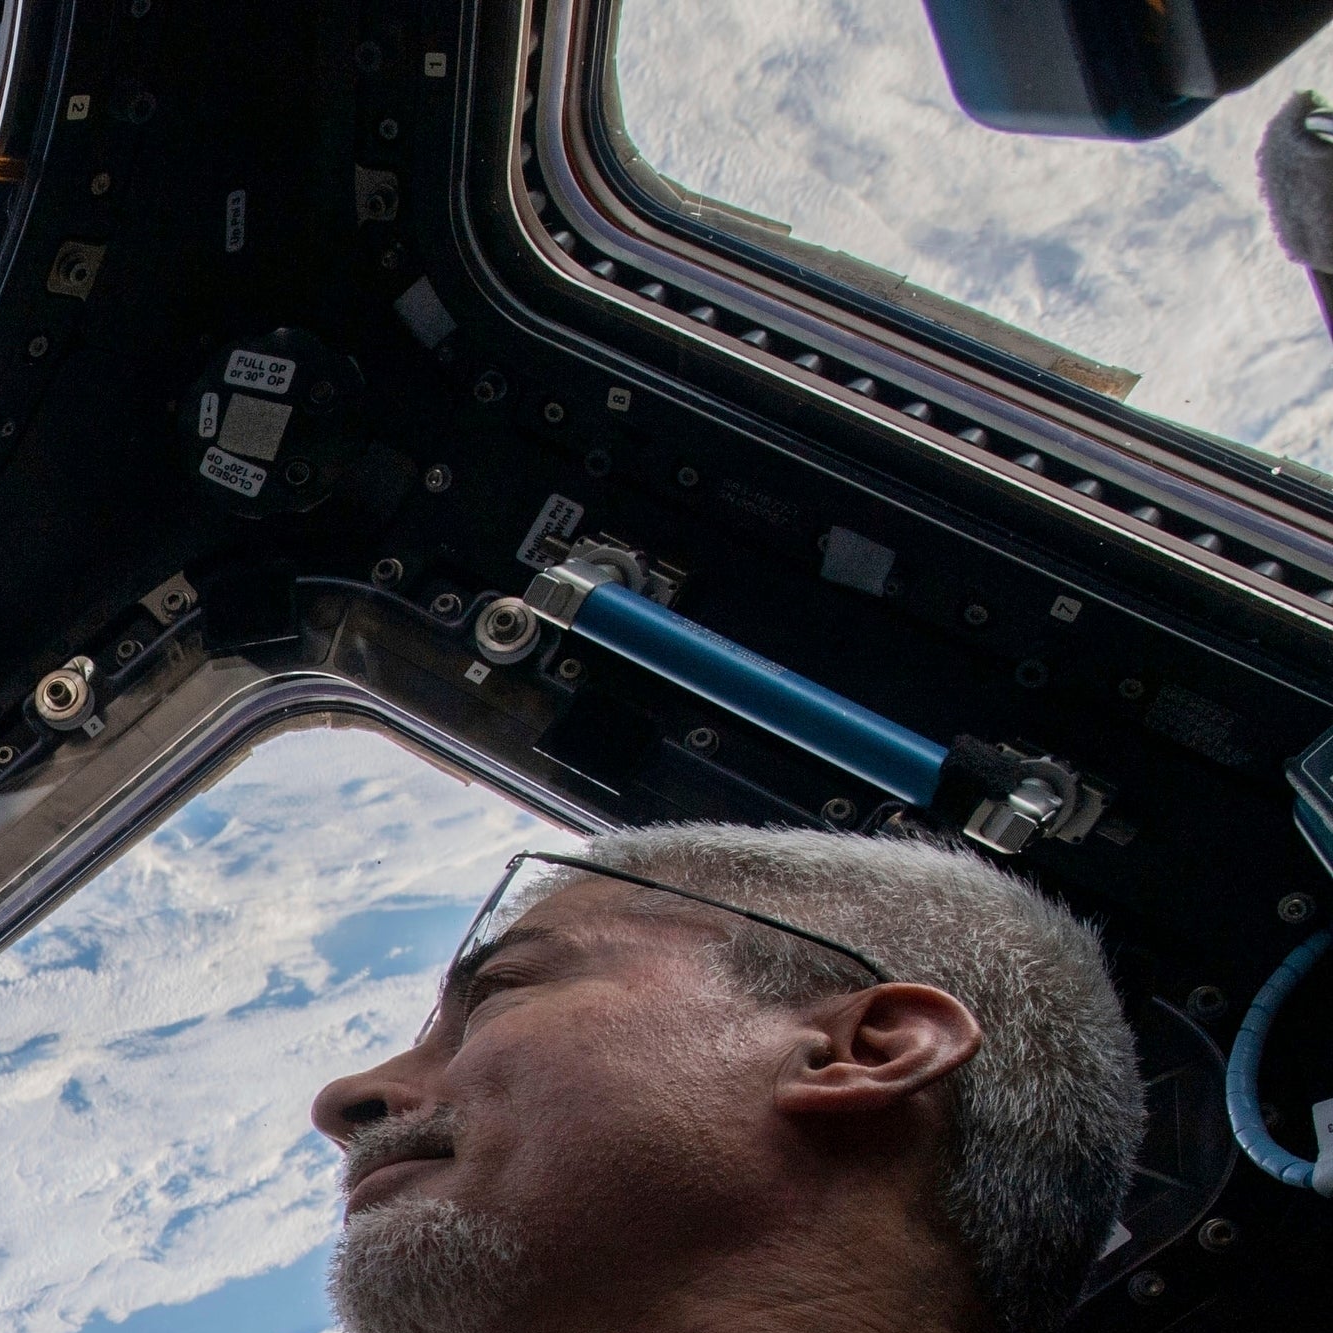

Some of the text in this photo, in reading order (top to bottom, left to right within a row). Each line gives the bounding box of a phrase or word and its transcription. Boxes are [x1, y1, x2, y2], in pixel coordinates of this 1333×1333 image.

[236, 356, 286, 374] FULL OP
[229, 369, 242, 379] or
[267, 375, 286, 387] OP
[612, 394, 625, 405] 8
[203, 417, 213, 433] CL
[206, 453, 222, 466] OP
[207, 464, 252, 491] CLOSED
[251, 471, 264, 482] or
[1057, 603, 1073, 615] 7
